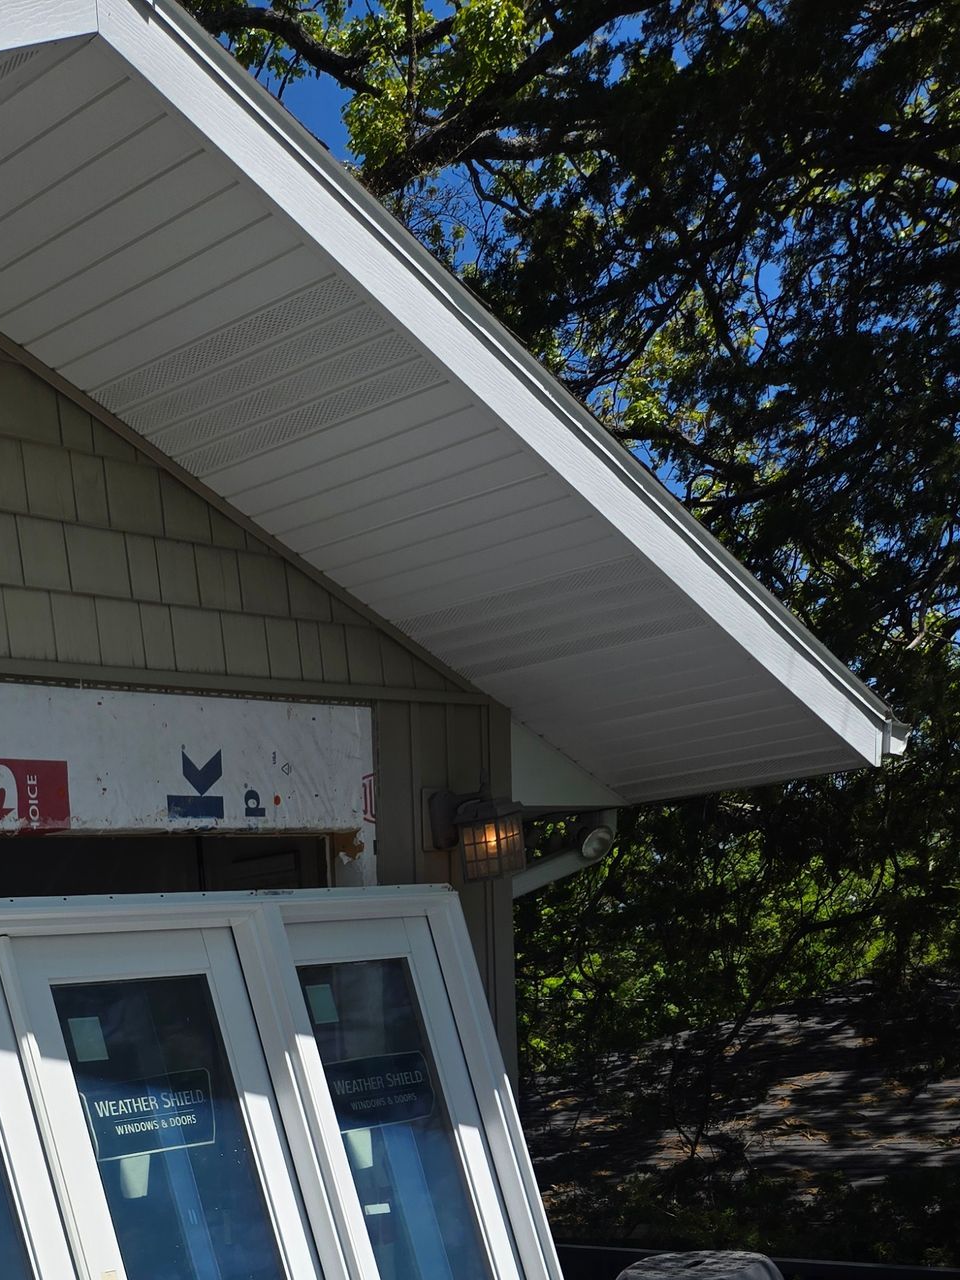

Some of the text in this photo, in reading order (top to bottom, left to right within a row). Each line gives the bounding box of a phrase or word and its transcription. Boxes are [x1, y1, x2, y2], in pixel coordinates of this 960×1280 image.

[333, 1076, 385, 1096] WEATHER
[94, 1095, 159, 1118] WEATHER
[350, 1092, 418, 1111] WINDOWS & DOORS
[114, 1114, 197, 1136] WINDOWS & DOORS
